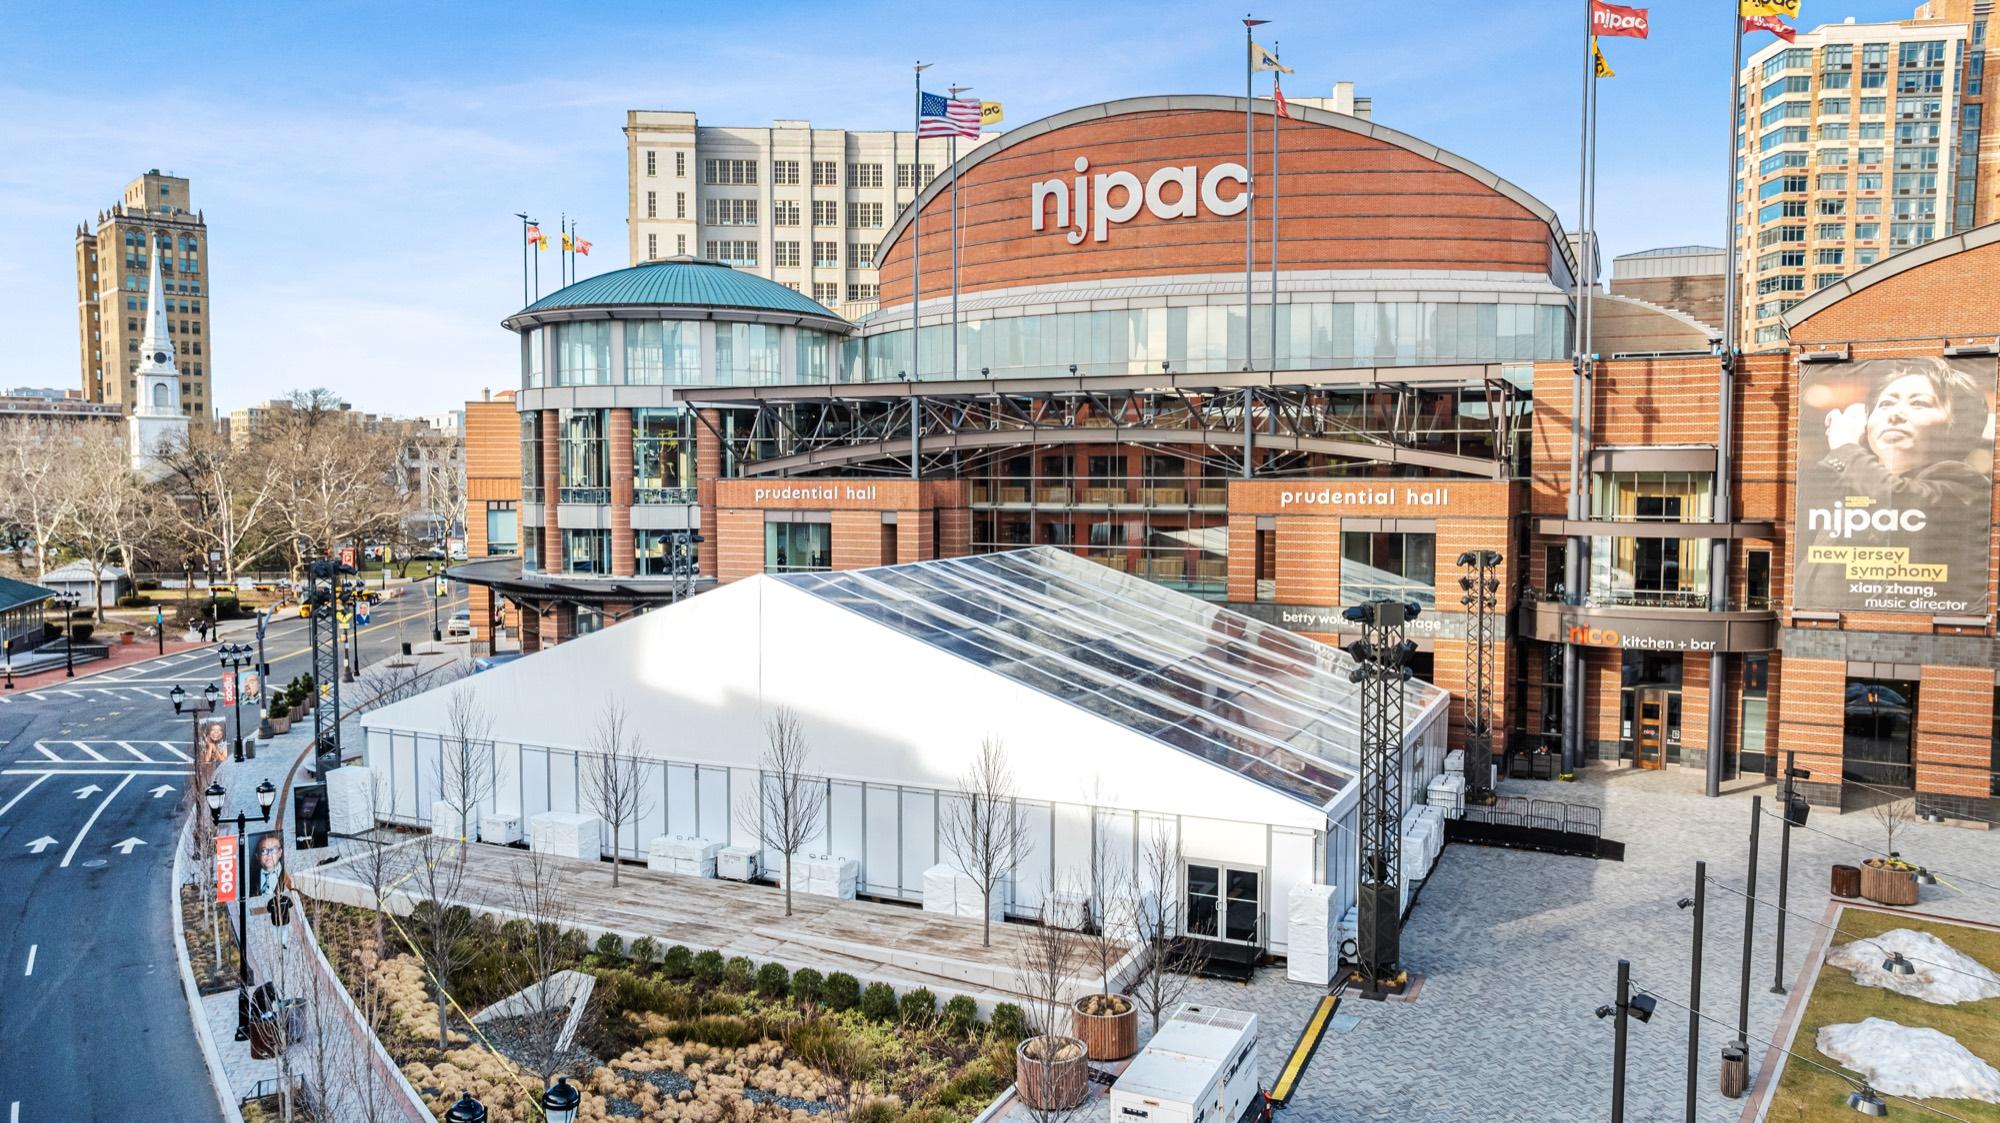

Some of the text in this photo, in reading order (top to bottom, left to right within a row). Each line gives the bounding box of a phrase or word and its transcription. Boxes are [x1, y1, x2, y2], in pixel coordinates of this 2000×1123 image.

[1594, 9, 1647, 29] njpac
[1032, 156, 1254, 245] njpac
[755, 486, 876, 502] prudential hall
[1280, 488, 1448, 508] prudential hall
[1808, 500, 1927, 539] njpac
[1812, 547, 1905, 564] new jersey
[1850, 564, 1943, 581] symphony
[1850, 582, 1937, 598] xian zhang,
[1865, 598, 1968, 611] music director
[1282, 610, 1316, 627] betty
[1404, 618, 1441, 632] stage
[1569, 620, 1619, 646] nico
[1622, 635, 1675, 650] kitchen
[1690, 637, 1717, 650] bar
[217, 844, 237, 894] njpac
